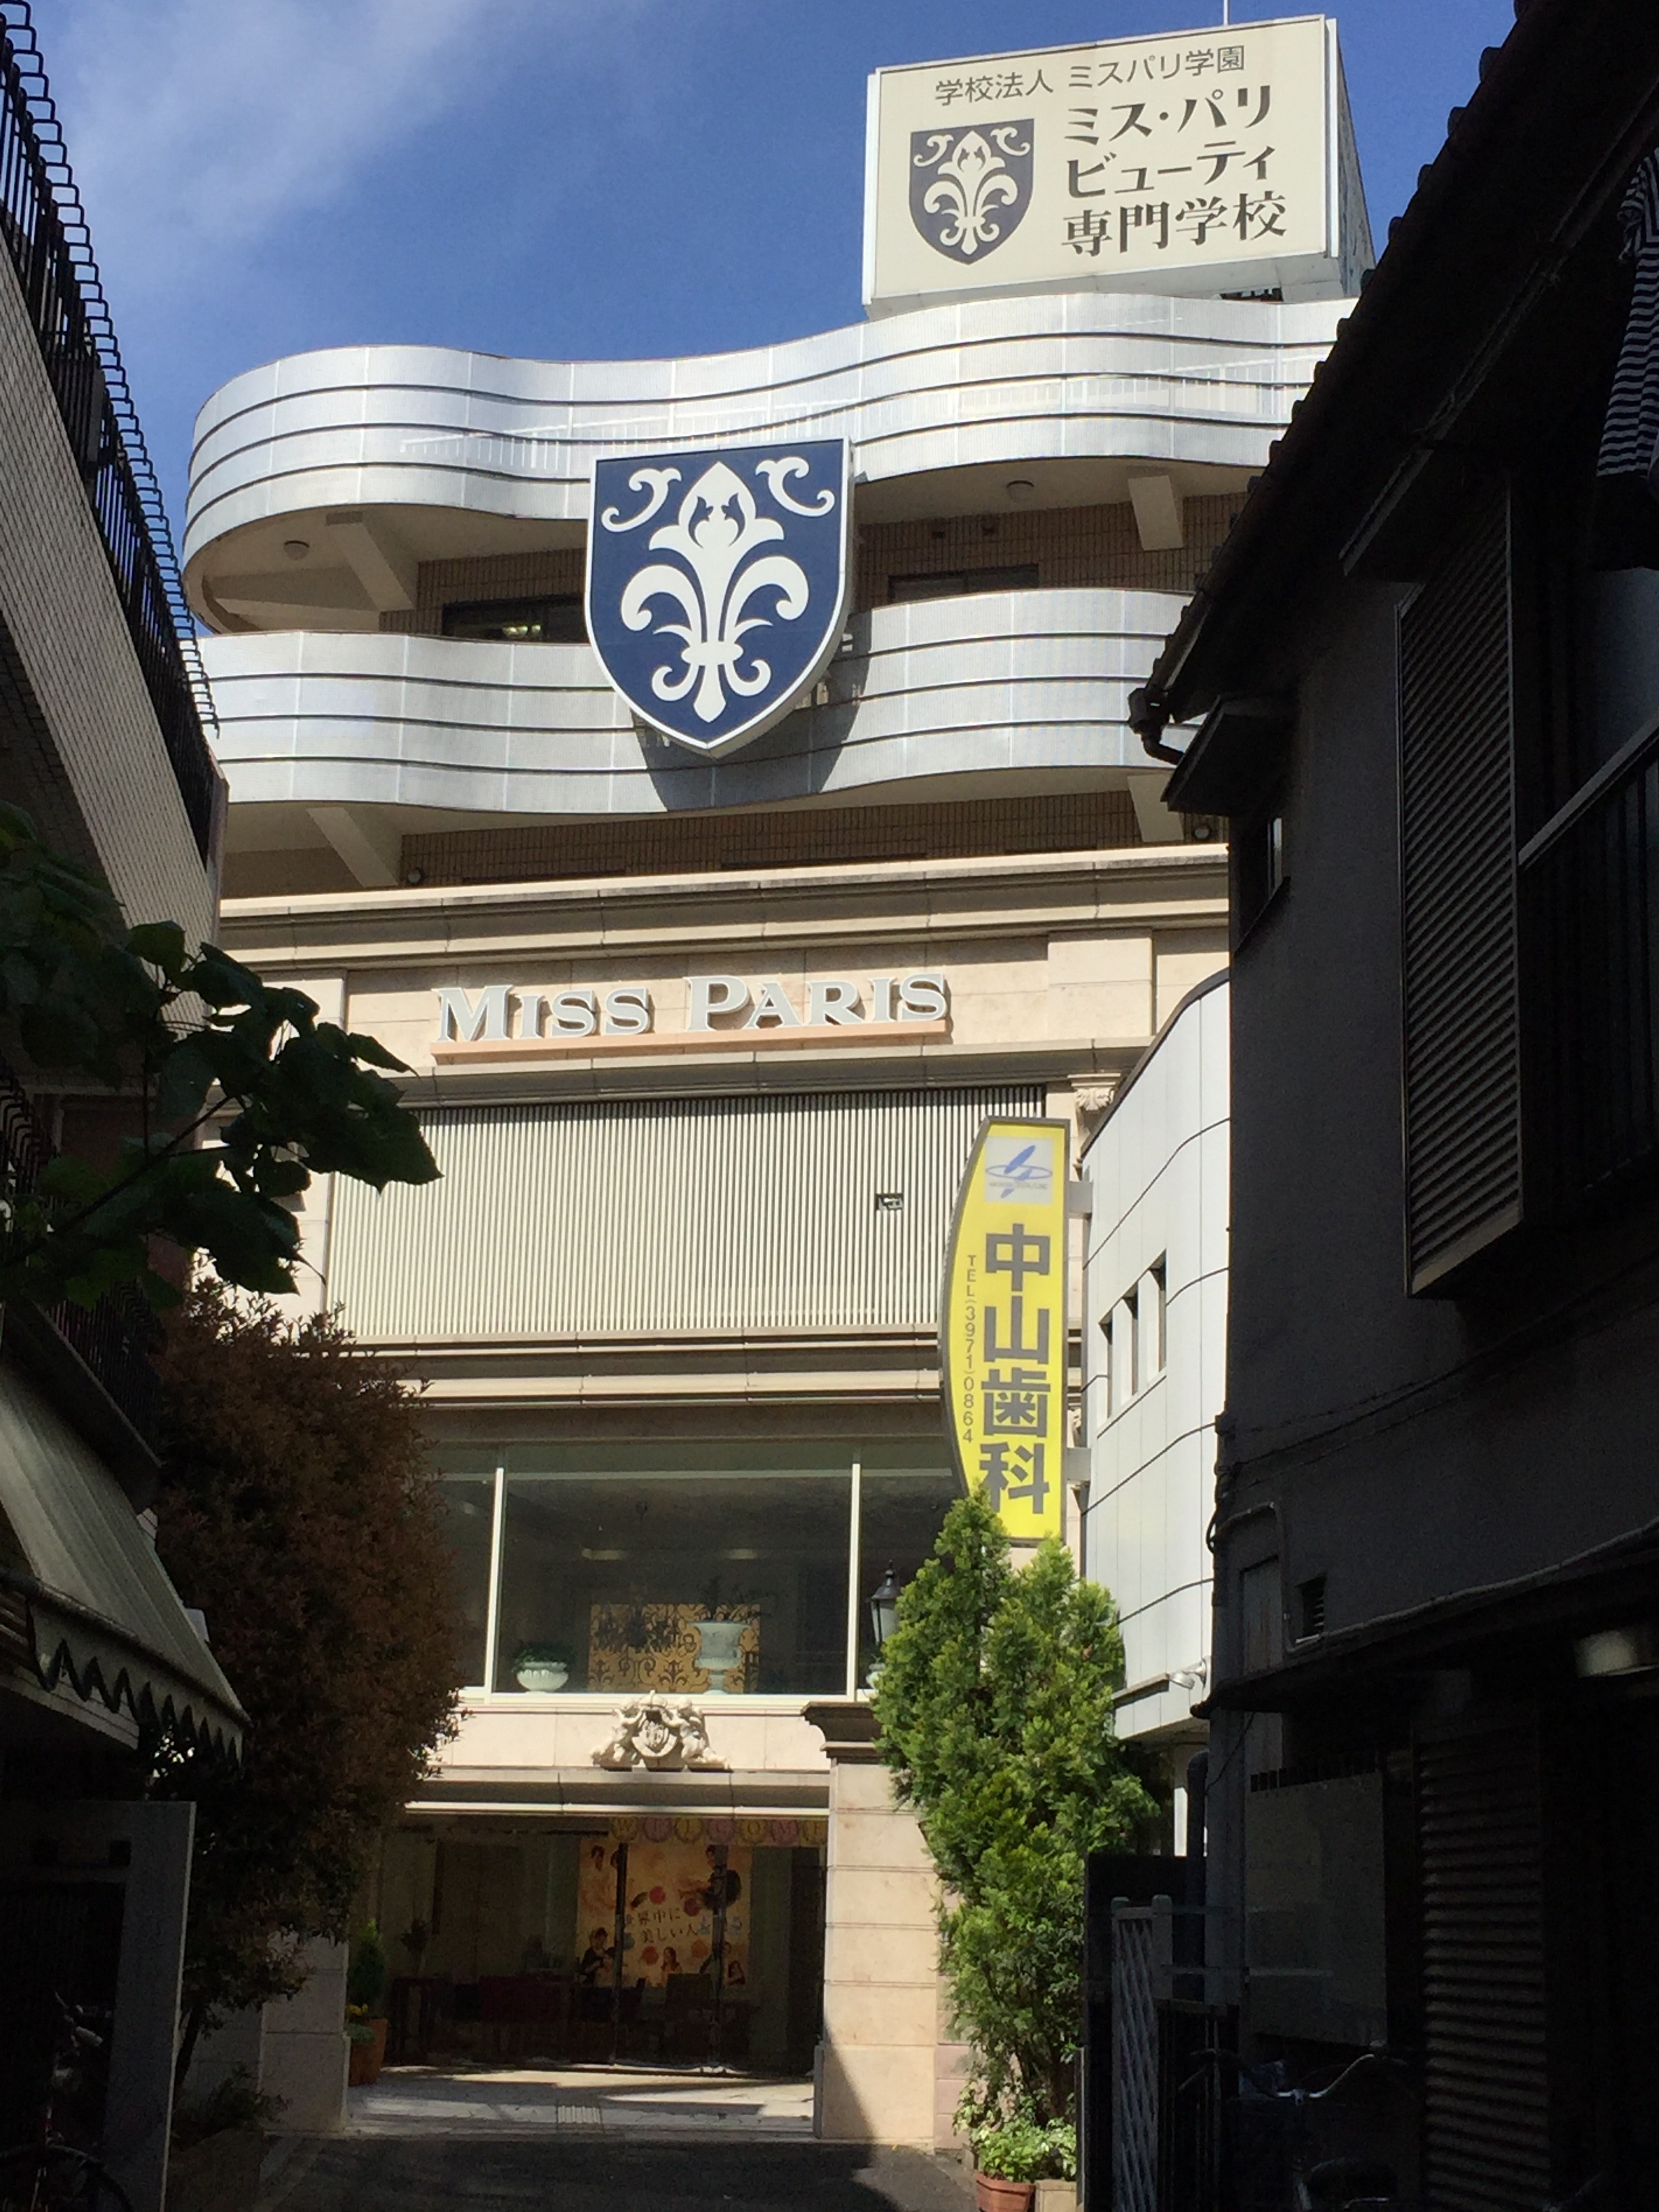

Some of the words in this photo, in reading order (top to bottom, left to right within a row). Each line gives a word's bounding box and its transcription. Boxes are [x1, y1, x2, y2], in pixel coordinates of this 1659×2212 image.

[935, 70, 1054, 106] 学校法人
[1068, 45, 1246, 89] ミスパリ学園
[1064, 85, 1271, 146] ミス・パリ
[1066, 140, 1276, 199] ビューティ
[1061, 190, 1287, 258] 専門学校
[979, 1223, 1051, 1515] 中山歯科
